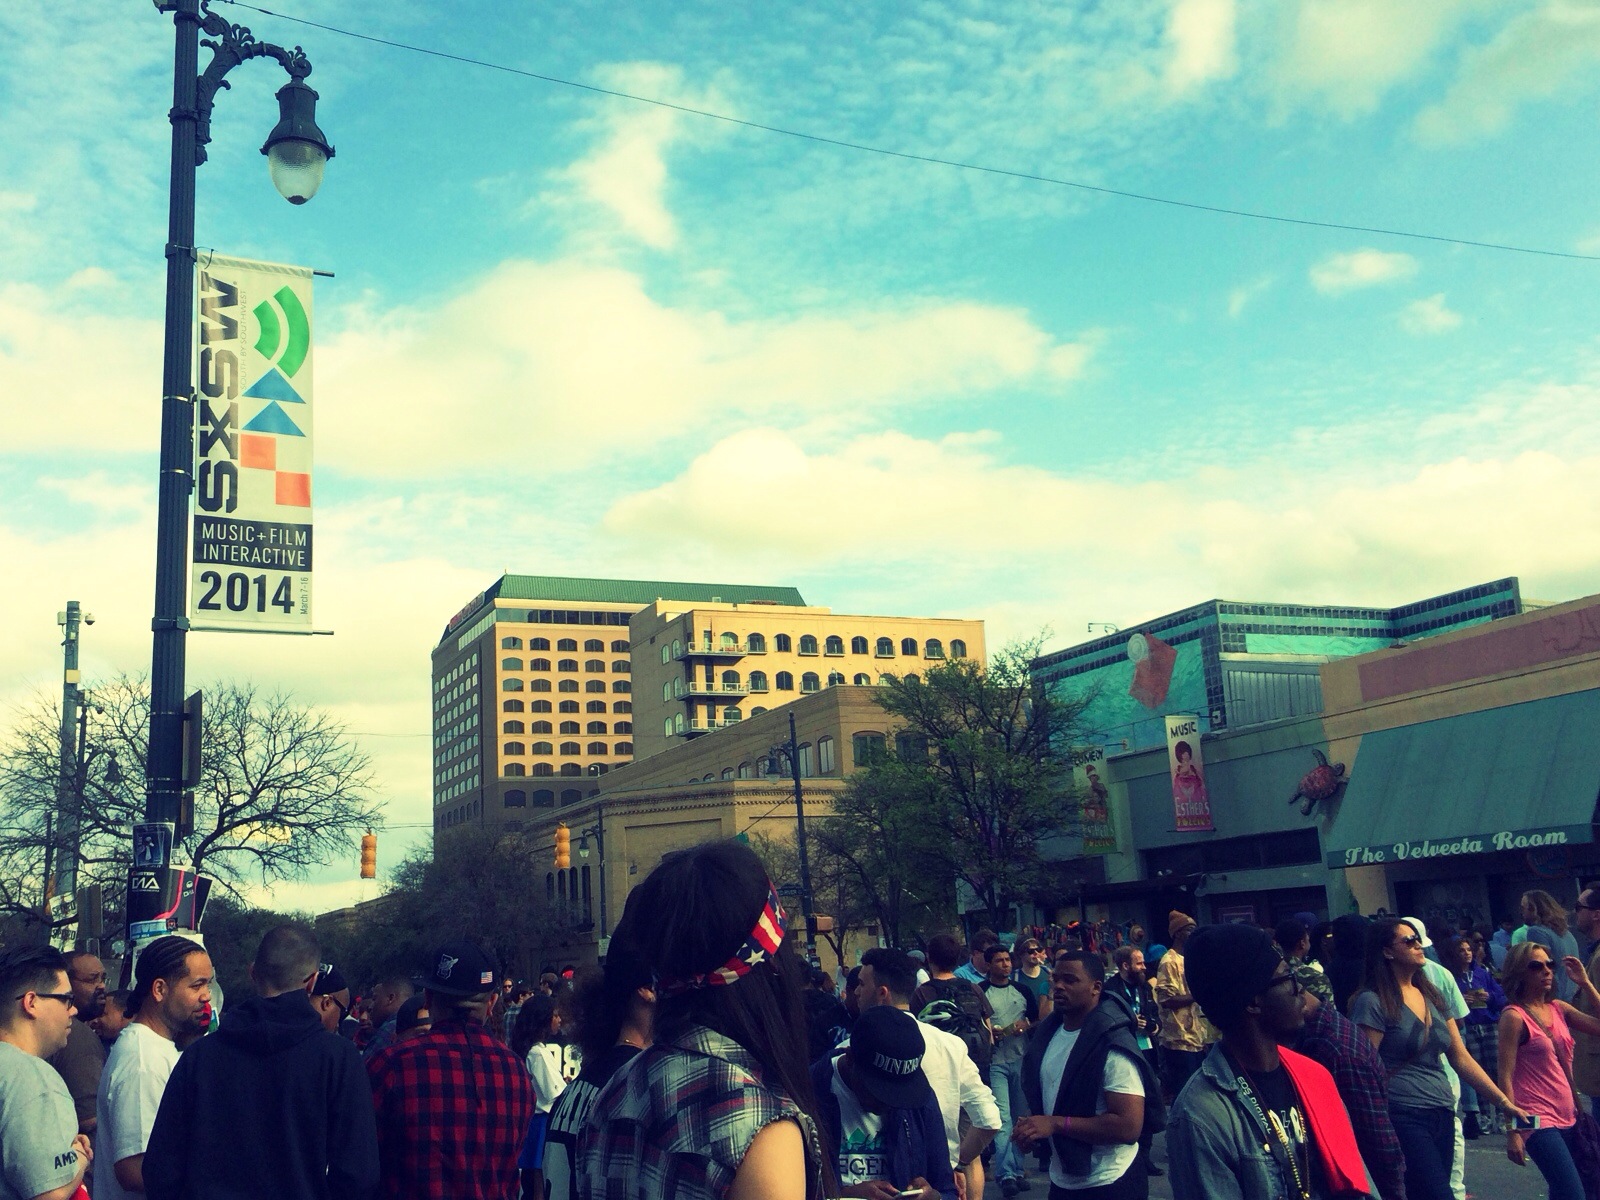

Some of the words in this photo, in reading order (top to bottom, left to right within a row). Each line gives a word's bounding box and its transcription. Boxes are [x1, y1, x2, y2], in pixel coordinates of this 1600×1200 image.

[239, 289, 248, 342] SOUTHWEST
[239, 344, 248, 357] BY
[239, 358, 248, 390] SOUTH
[198, 270, 239, 513] SXSW
[203, 543, 306, 567] INTERACTIVE
[197, 570, 295, 614] 2014
[299, 576, 309, 593] 7-16
[299, 596, 309, 615] March
[1169, 721, 1198, 739] MUSIC
[1174, 796, 1210, 816] ESTHER'S
[1345, 846, 1386, 866] The
[1392, 837, 1485, 860] Velveeta
[1492, 830, 1569, 851] Room
[1237, 1076, 1253, 1096] EOS
[1250, 1096, 1272, 1135] DIGITAL
